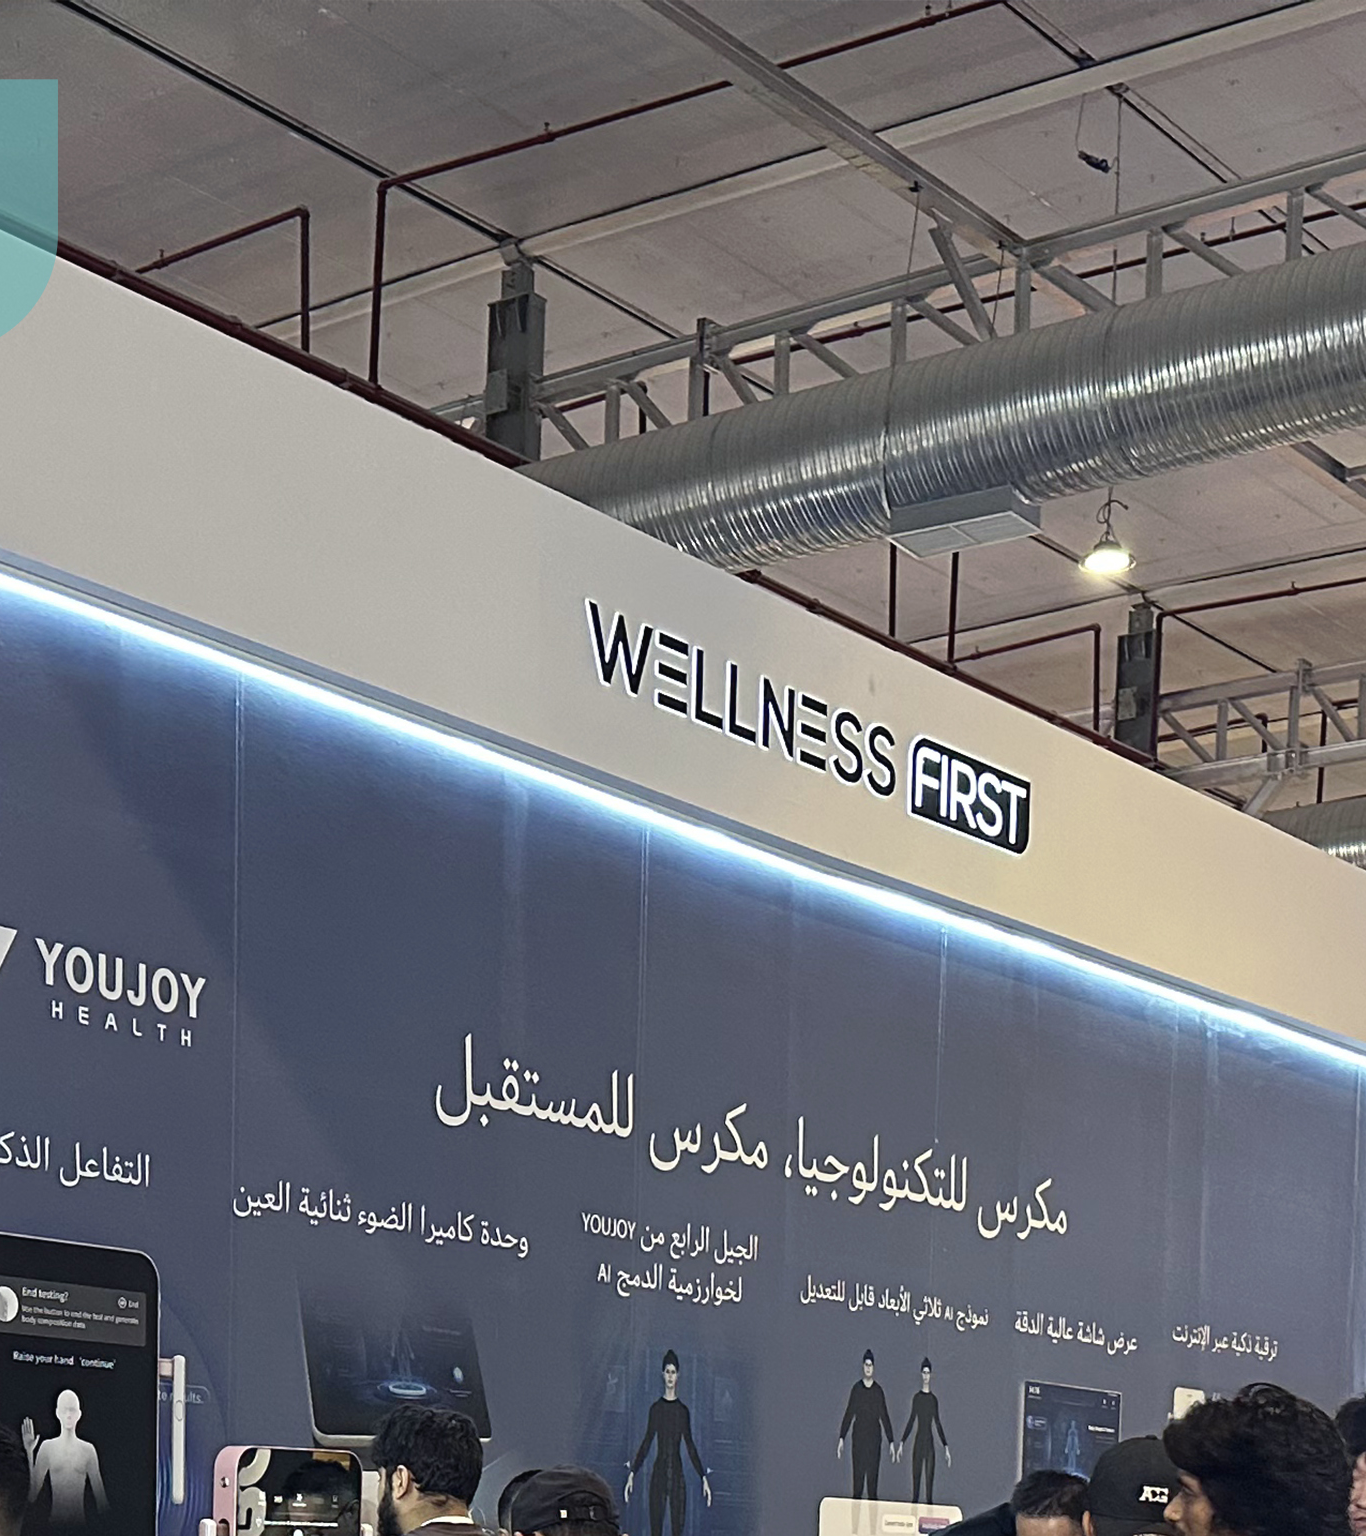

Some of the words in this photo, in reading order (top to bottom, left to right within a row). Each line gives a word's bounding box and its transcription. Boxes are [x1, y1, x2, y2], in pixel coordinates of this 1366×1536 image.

[585, 598, 896, 798] WELLNESS
[914, 742, 1027, 846] FIRST
[36, 938, 207, 1019] YOUJOY
[51, 999, 193, 1047] HEALTH
[435, 1033, 634, 1139] للمستقبل
[648, 1102, 769, 1171] مكرس
[59, 1142, 151, 1188] التفاعل
[233, 1180, 291, 1218] العين
[298, 1186, 352, 1226] ثنائية
[357, 1202, 413, 1234] الضوء
[976, 1178, 1068, 1239] مكرس
[420, 1205, 475, 1246] كاميرا
[480, 1220, 529, 1258] وحدة
[581, 1212, 637, 1241] YOUJOY
[640, 1225, 665, 1252] من
[669, 1223, 710, 1260] الرابع
[713, 1229, 759, 1266] الجيل
[597, 1263, 611, 1284] AI
[616, 1262, 664, 1297] الدمج
[668, 1267, 743, 1306] لخوارزمية
[800, 1274, 846, 1305] للتعديل
[22, 1286, 37, 1298] End
[38, 1288, 69, 1304] testing?
[848, 1282, 875, 1312] قابل
[955, 1304, 990, 1332] نموذج
